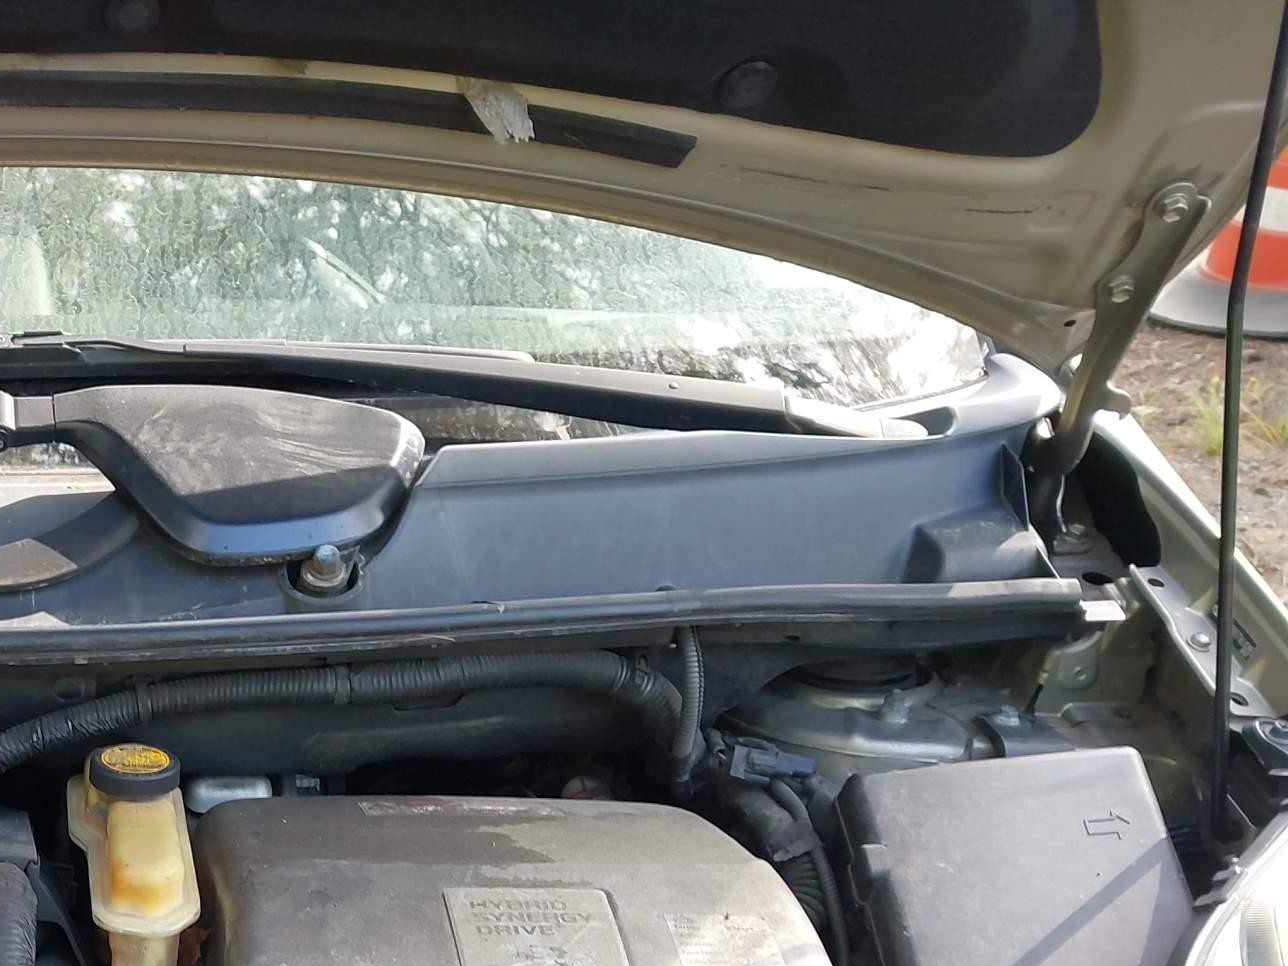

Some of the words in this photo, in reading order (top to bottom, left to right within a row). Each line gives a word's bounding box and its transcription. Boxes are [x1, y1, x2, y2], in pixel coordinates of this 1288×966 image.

[469, 898, 568, 912] HYBRID
[471, 911, 593, 924] SYNERGY
[475, 924, 557, 936] DRIVE
